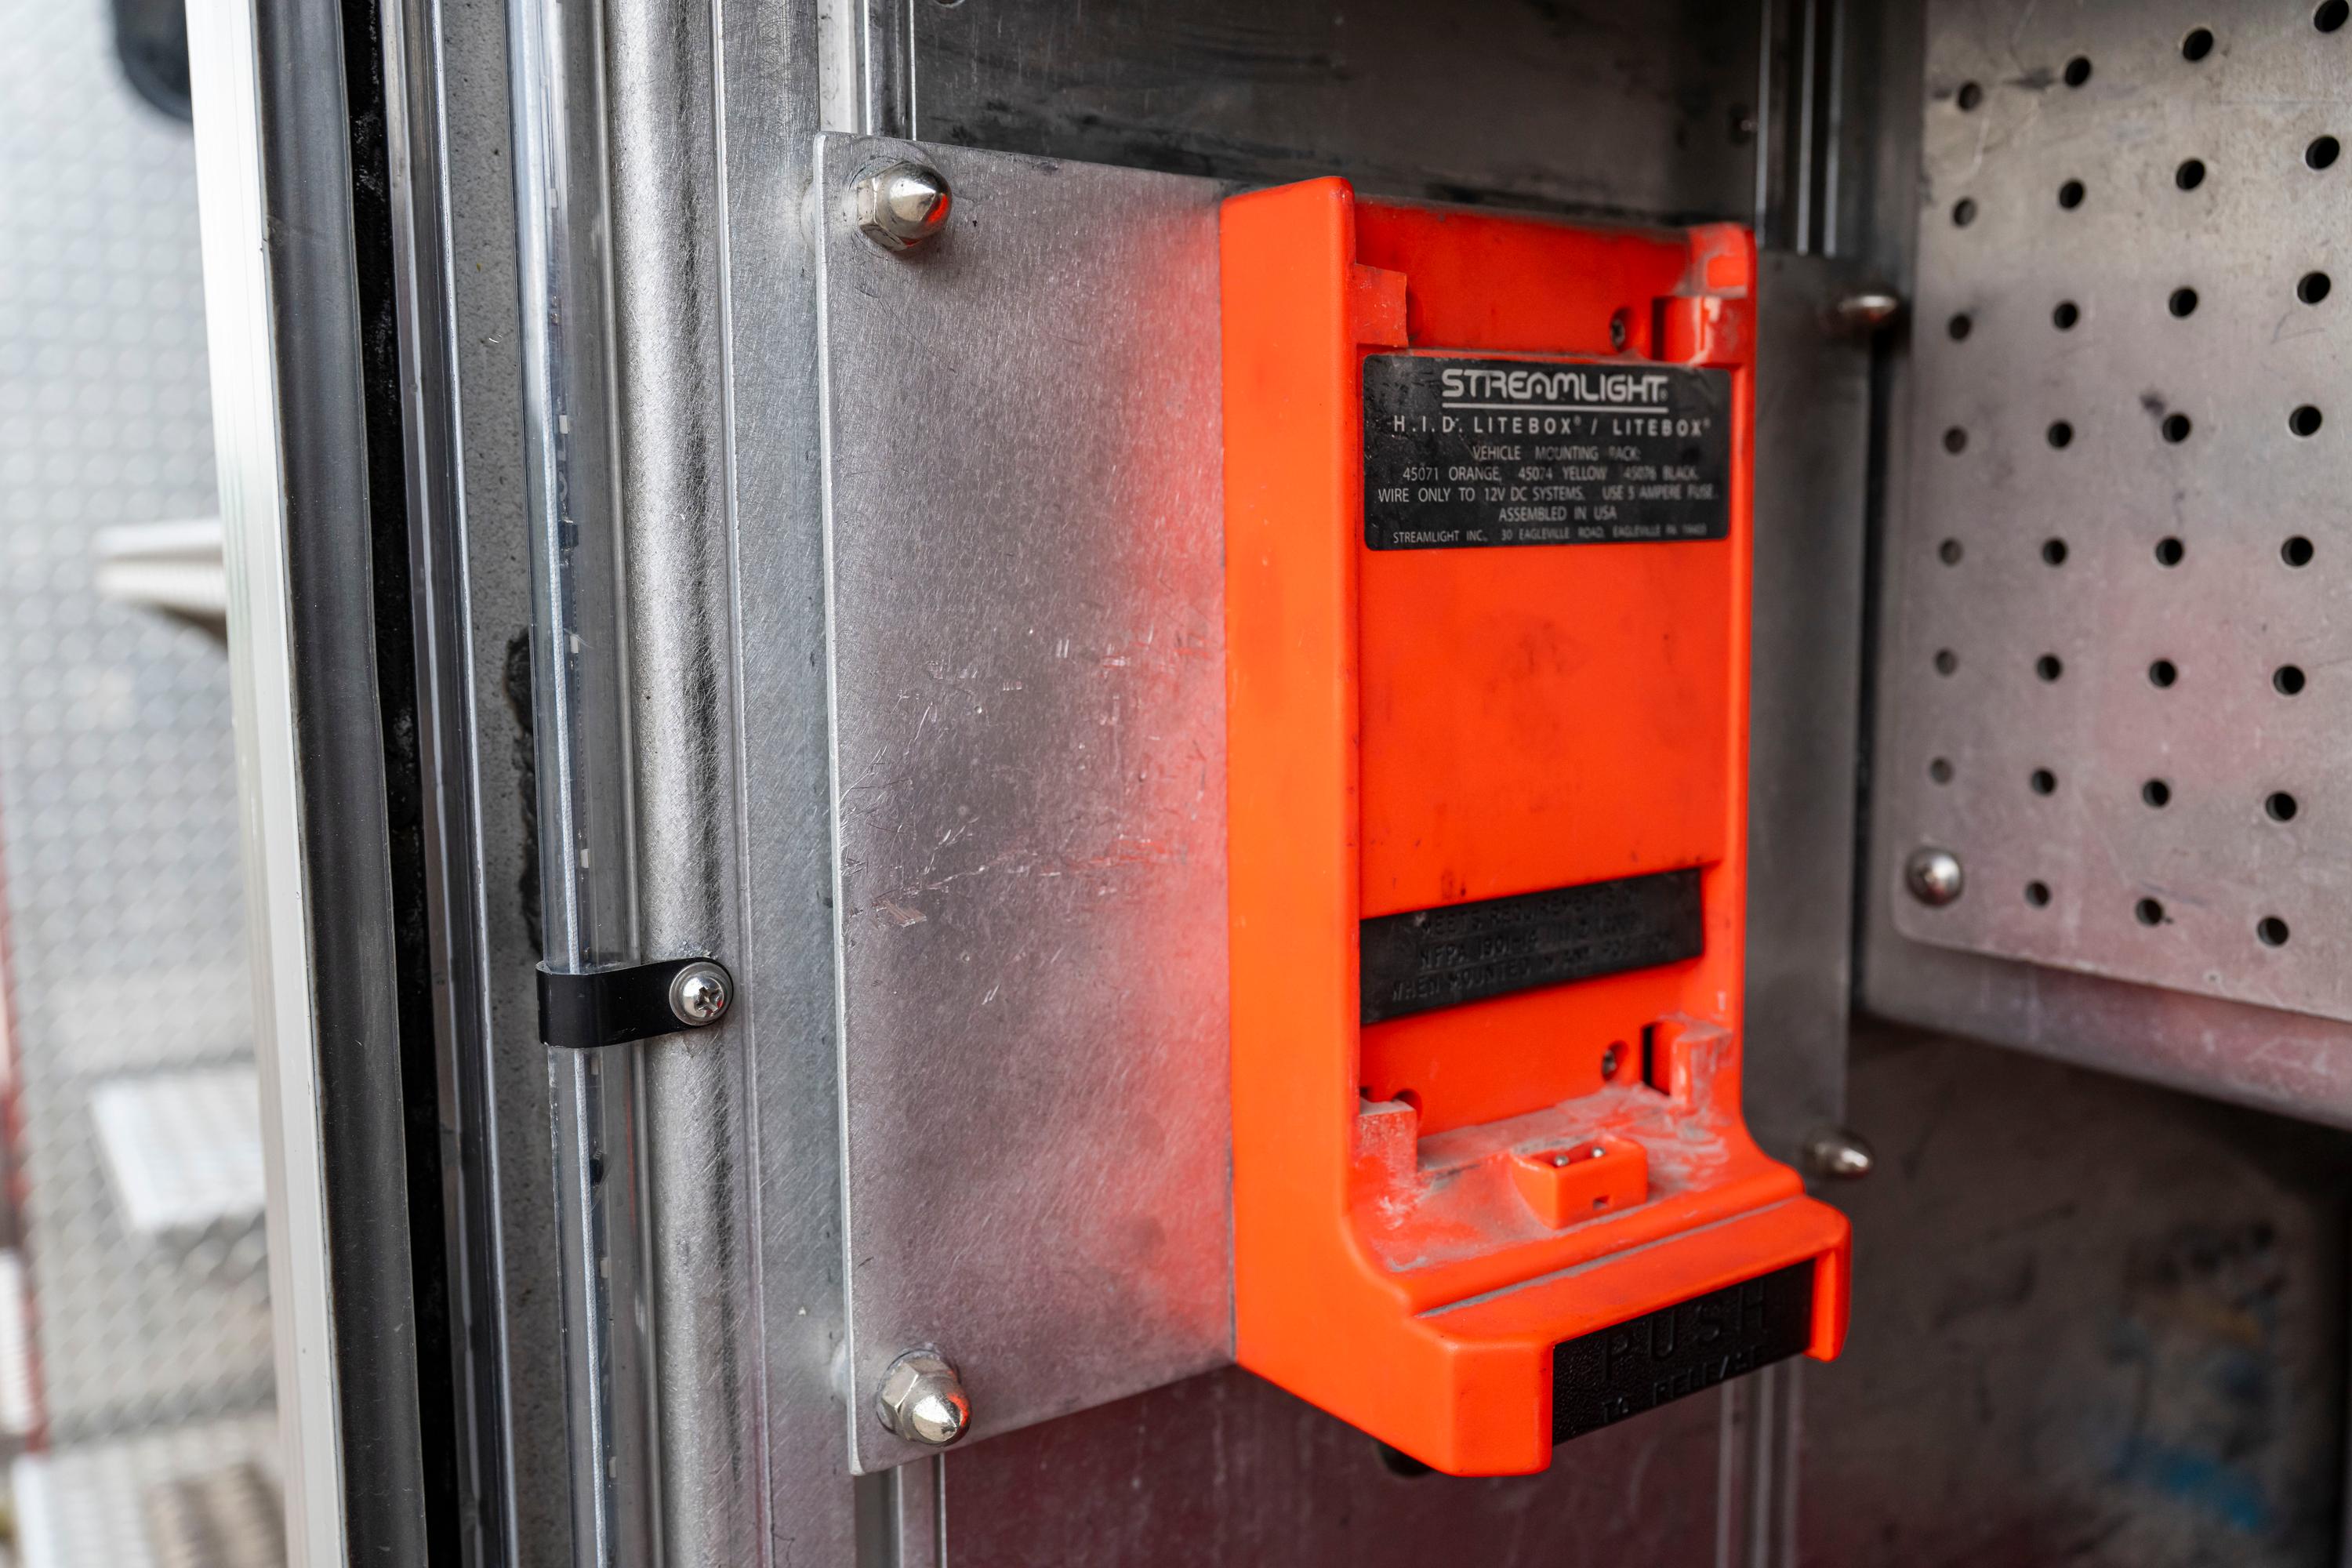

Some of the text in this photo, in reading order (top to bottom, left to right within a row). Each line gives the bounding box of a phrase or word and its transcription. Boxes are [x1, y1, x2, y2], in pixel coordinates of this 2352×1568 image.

[1393, 415, 1463, 433] H.I.D.
[1472, 445, 1521, 460] VEHICLE
[1535, 445, 1599, 461] MOUNTING
[1403, 466, 1439, 481] 45071
[1519, 466, 1553, 481] 45074
[1378, 488, 1410, 503] WIRE
[1417, 487, 1451, 502] ONLY
[1458, 487, 1475, 502] TO
[1484, 487, 1505, 502] 12V
[1510, 486, 1528, 502] DC
[1602, 485, 1624, 501] USE
[1639, 484, 1682, 500] AMPERE
[1498, 505, 1617, 522] ASSEMBLED IN USA
[1393, 530, 1460, 543] STREAMLIGHT
[1501, 528, 1513, 541] 30
[1519, 527, 1570, 540] EAGLEVILLE
[1601, 1280, 1766, 1382] PUSH
